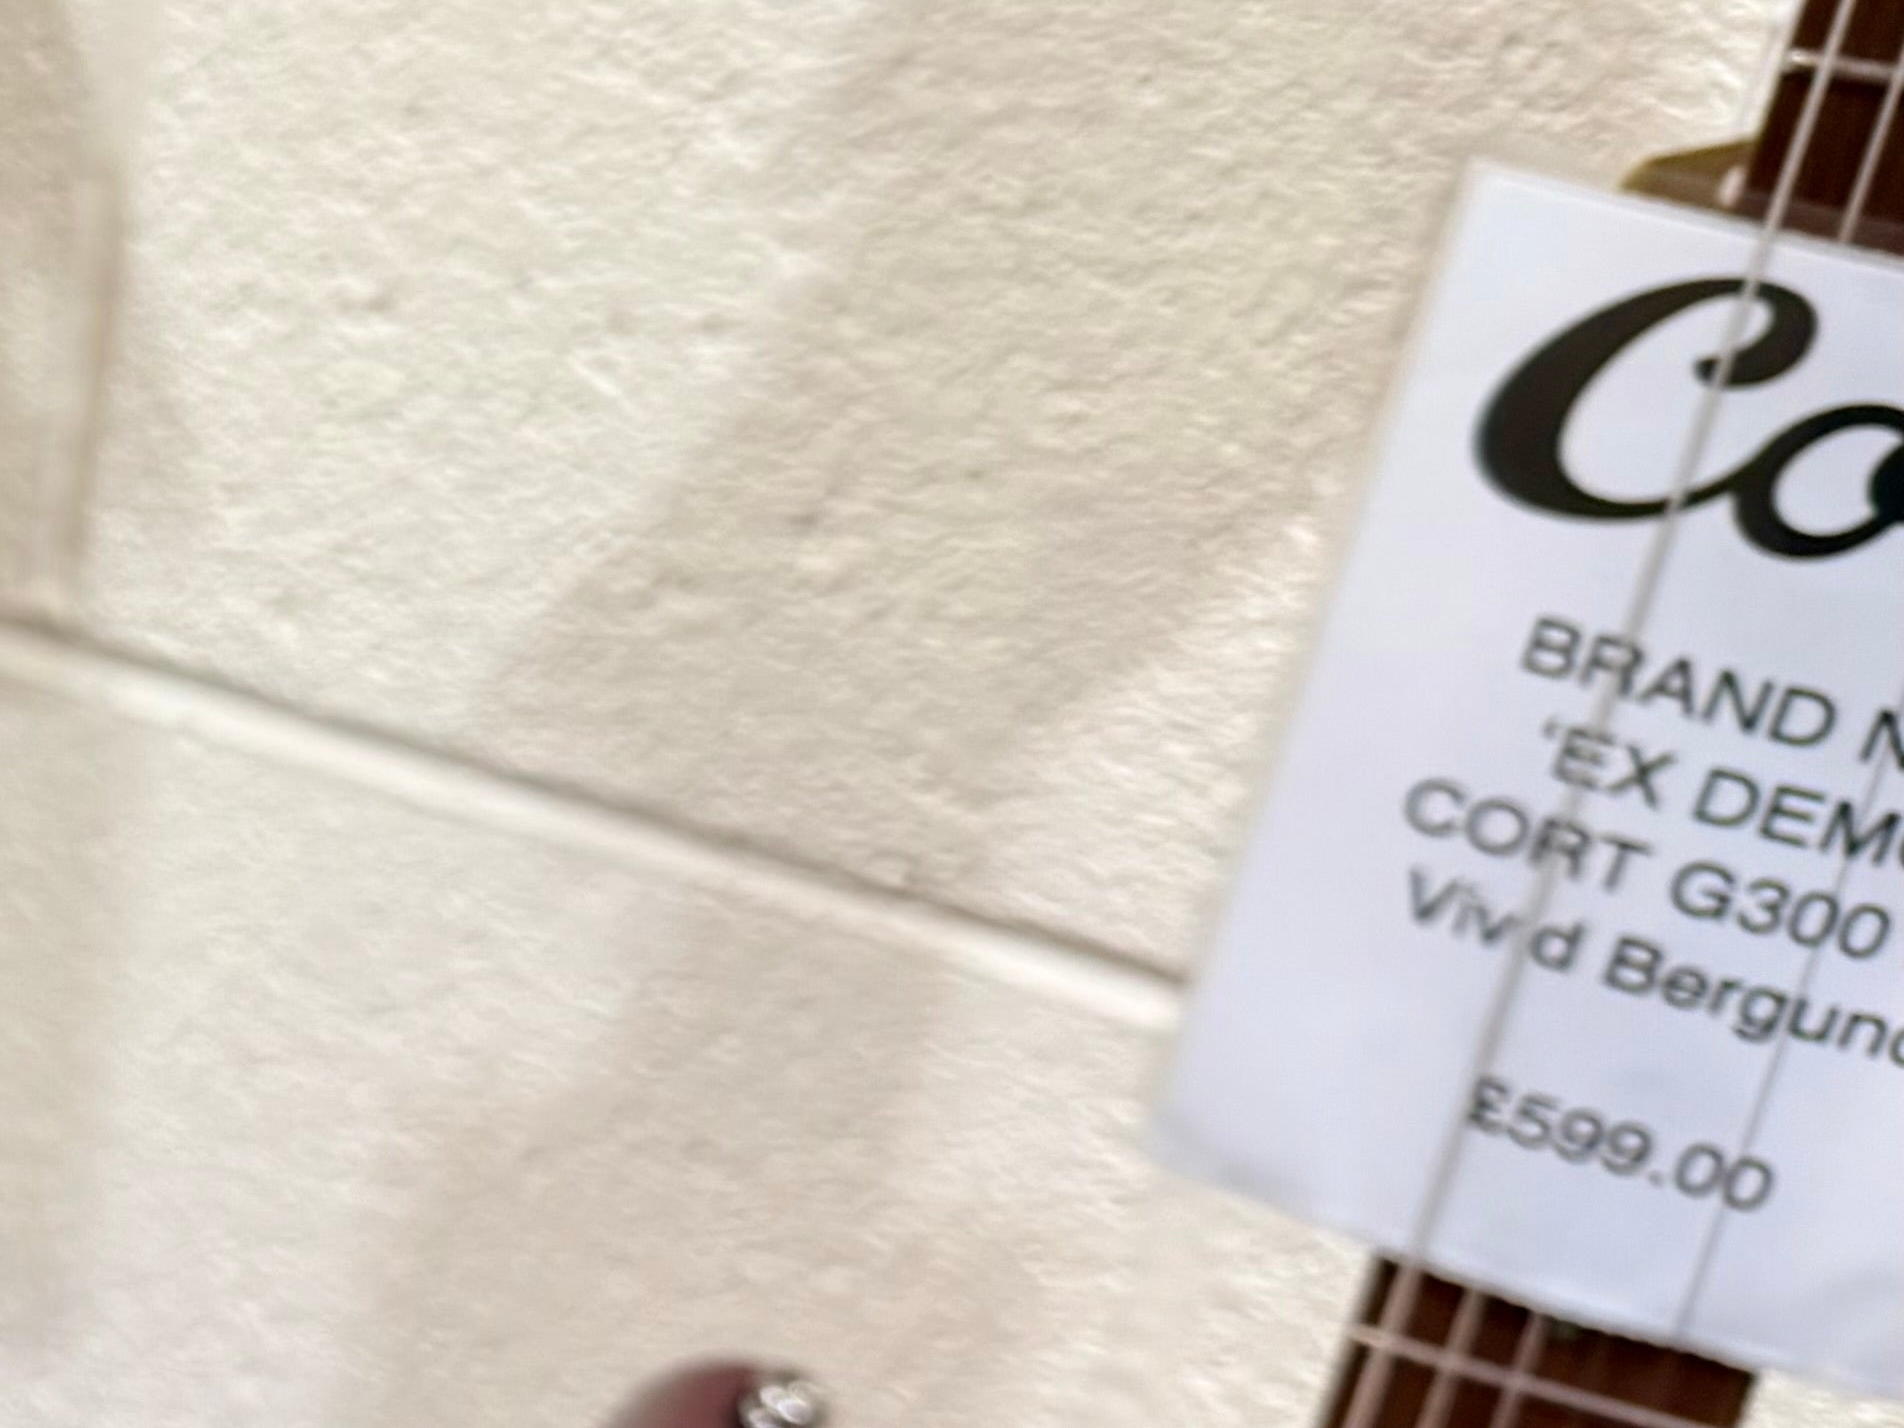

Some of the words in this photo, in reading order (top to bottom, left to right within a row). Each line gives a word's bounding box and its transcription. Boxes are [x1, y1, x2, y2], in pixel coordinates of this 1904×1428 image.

[1521, 615, 1837, 749] BRAND
[1402, 777, 1653, 893] CORT
[1668, 860, 1891, 961] G300
[1691, 766, 1904, 870] DEM
[1466, 1072, 1776, 1214] £599.00
